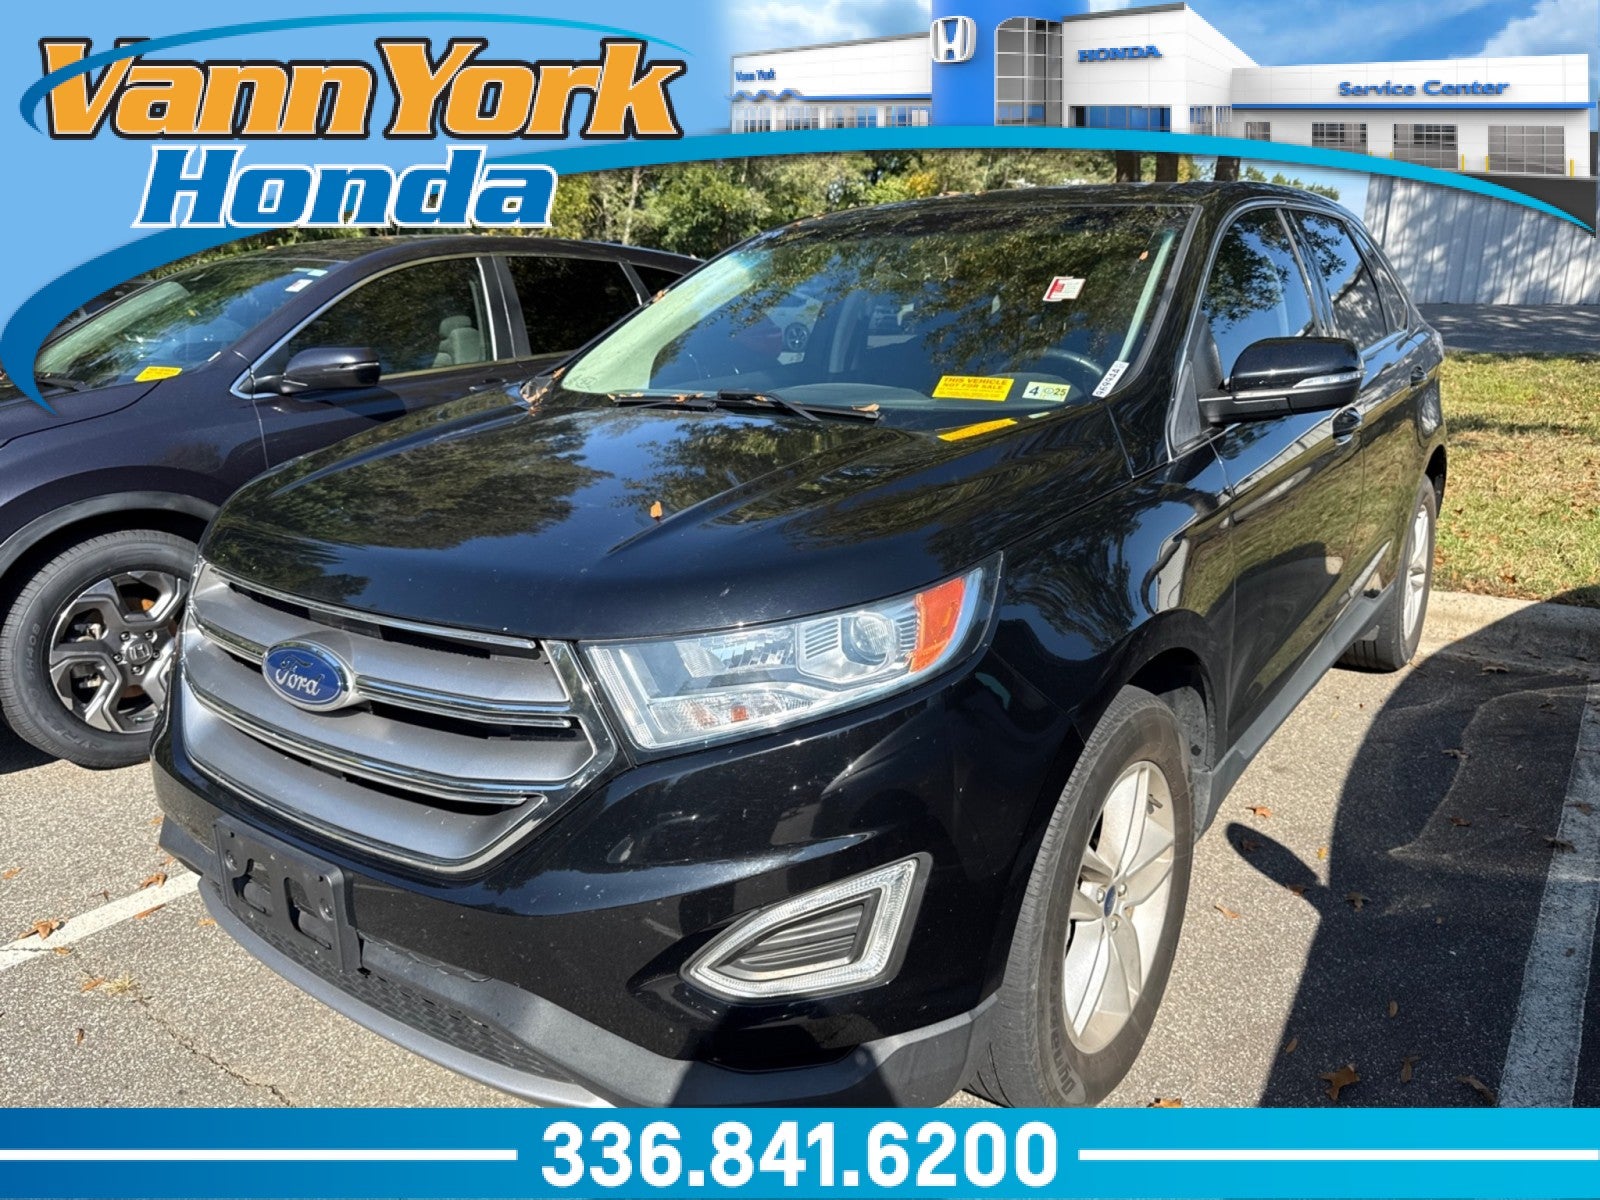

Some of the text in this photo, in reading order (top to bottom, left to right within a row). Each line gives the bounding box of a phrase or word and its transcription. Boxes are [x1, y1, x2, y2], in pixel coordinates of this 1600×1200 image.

[1028, 386, 1067, 396] 4 25
[275, 654, 326, 696] Ford
